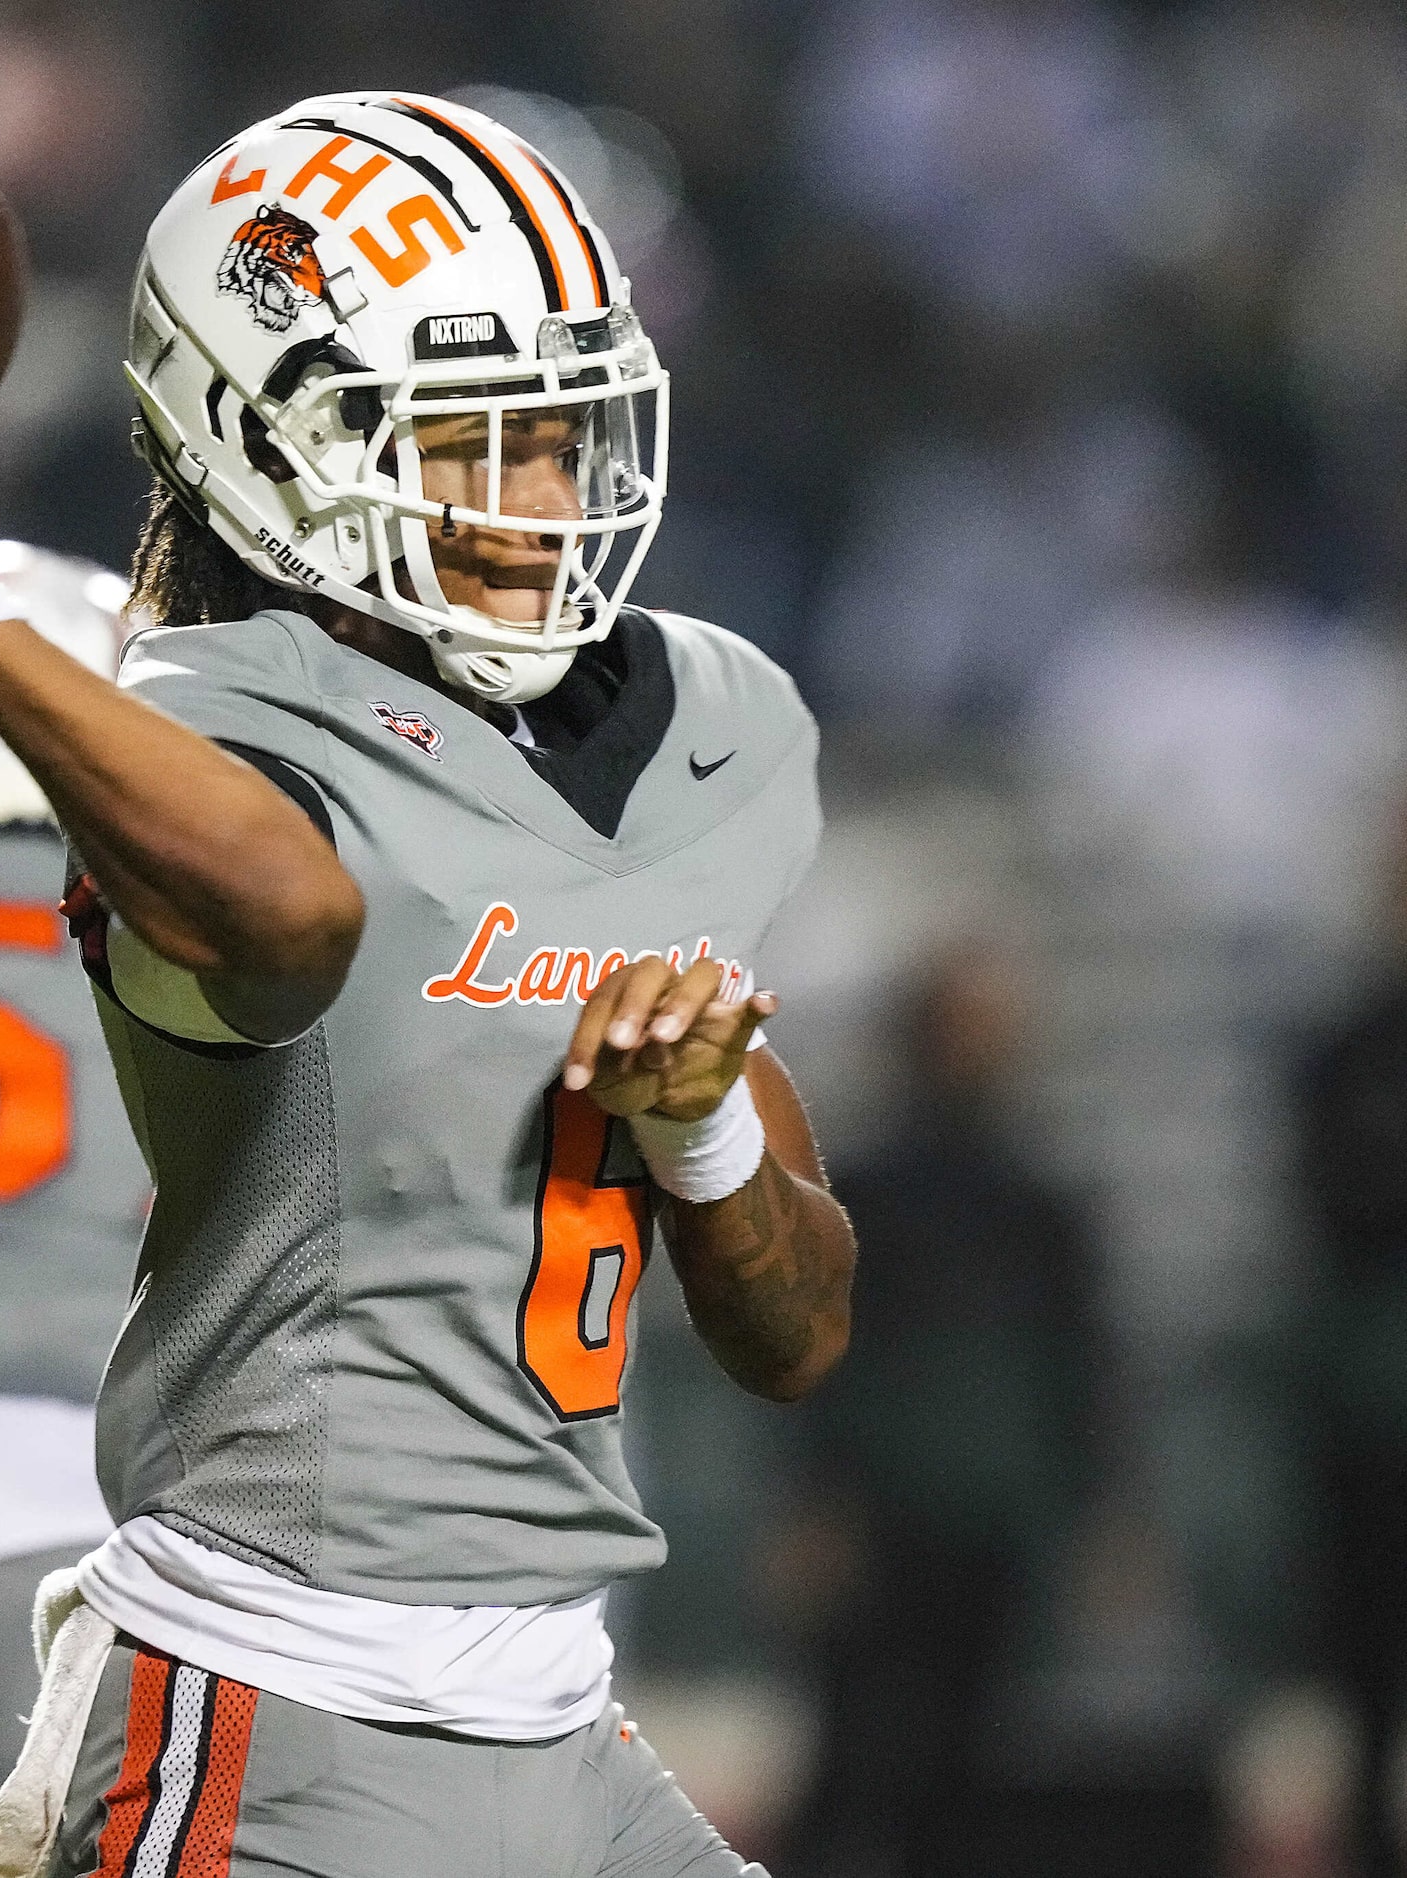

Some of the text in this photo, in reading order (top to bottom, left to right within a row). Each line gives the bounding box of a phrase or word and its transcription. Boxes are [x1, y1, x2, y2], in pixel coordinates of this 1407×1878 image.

[210, 135, 466, 288] LHS
[428, 315, 496, 345] NXTRND
[255, 526, 326, 588] schutt
[421, 902, 742, 1008] Lancr
[515, 1070, 654, 1423] 6
